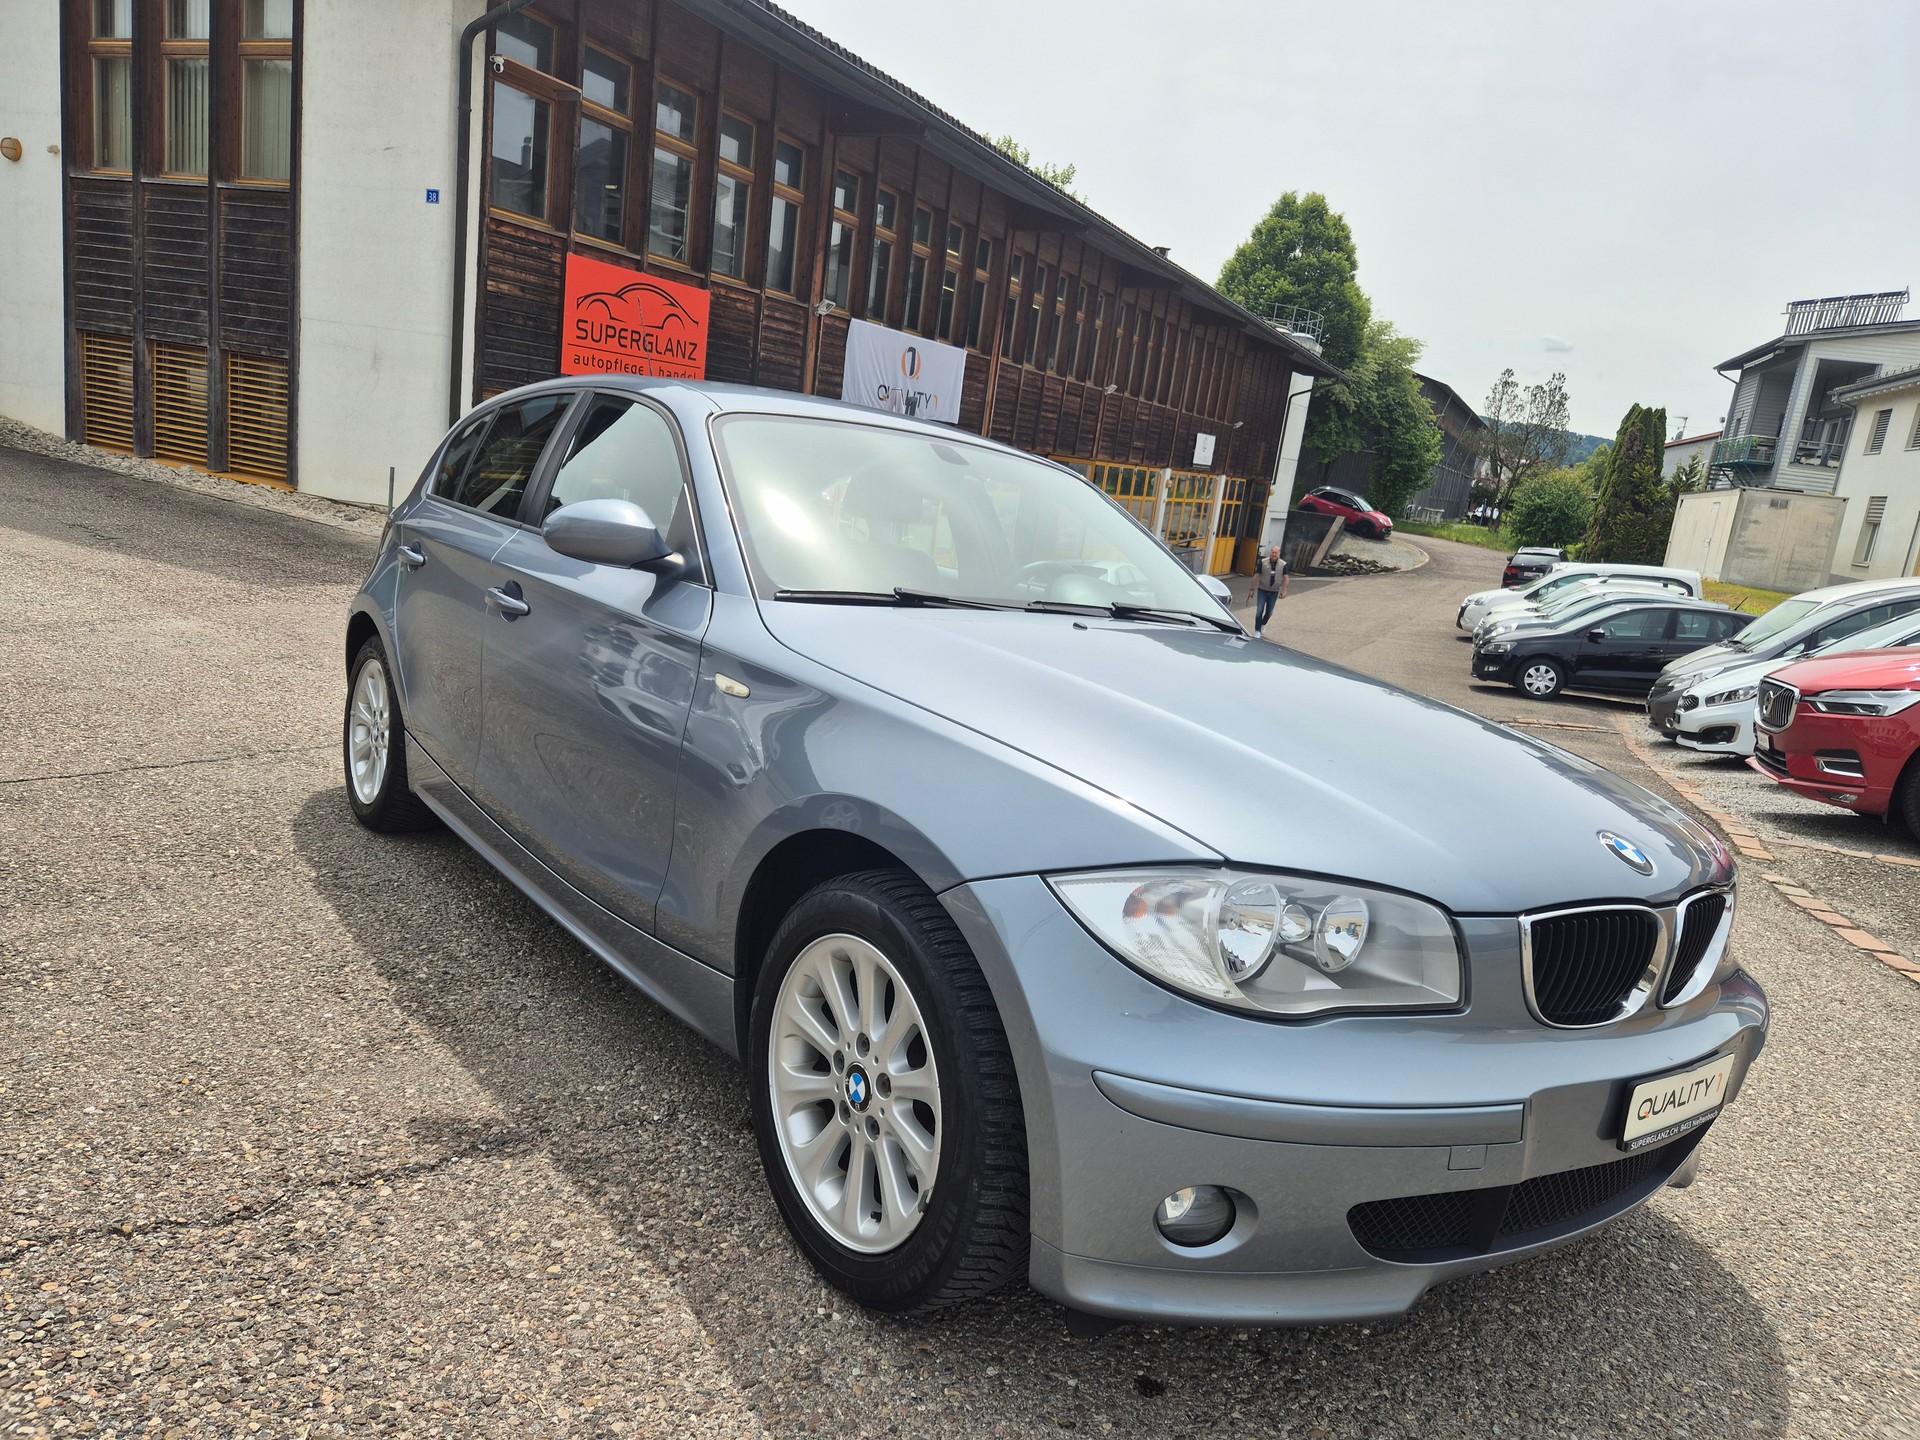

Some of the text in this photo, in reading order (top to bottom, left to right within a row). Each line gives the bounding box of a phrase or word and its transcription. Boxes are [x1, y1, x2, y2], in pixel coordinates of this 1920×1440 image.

[428, 191, 437, 202] 38
[575, 318, 698, 361] SUPERGLANZ
[573, 353, 645, 376] autopflege
[1630, 1127, 1679, 1151] SUPERGLANZ.CH
